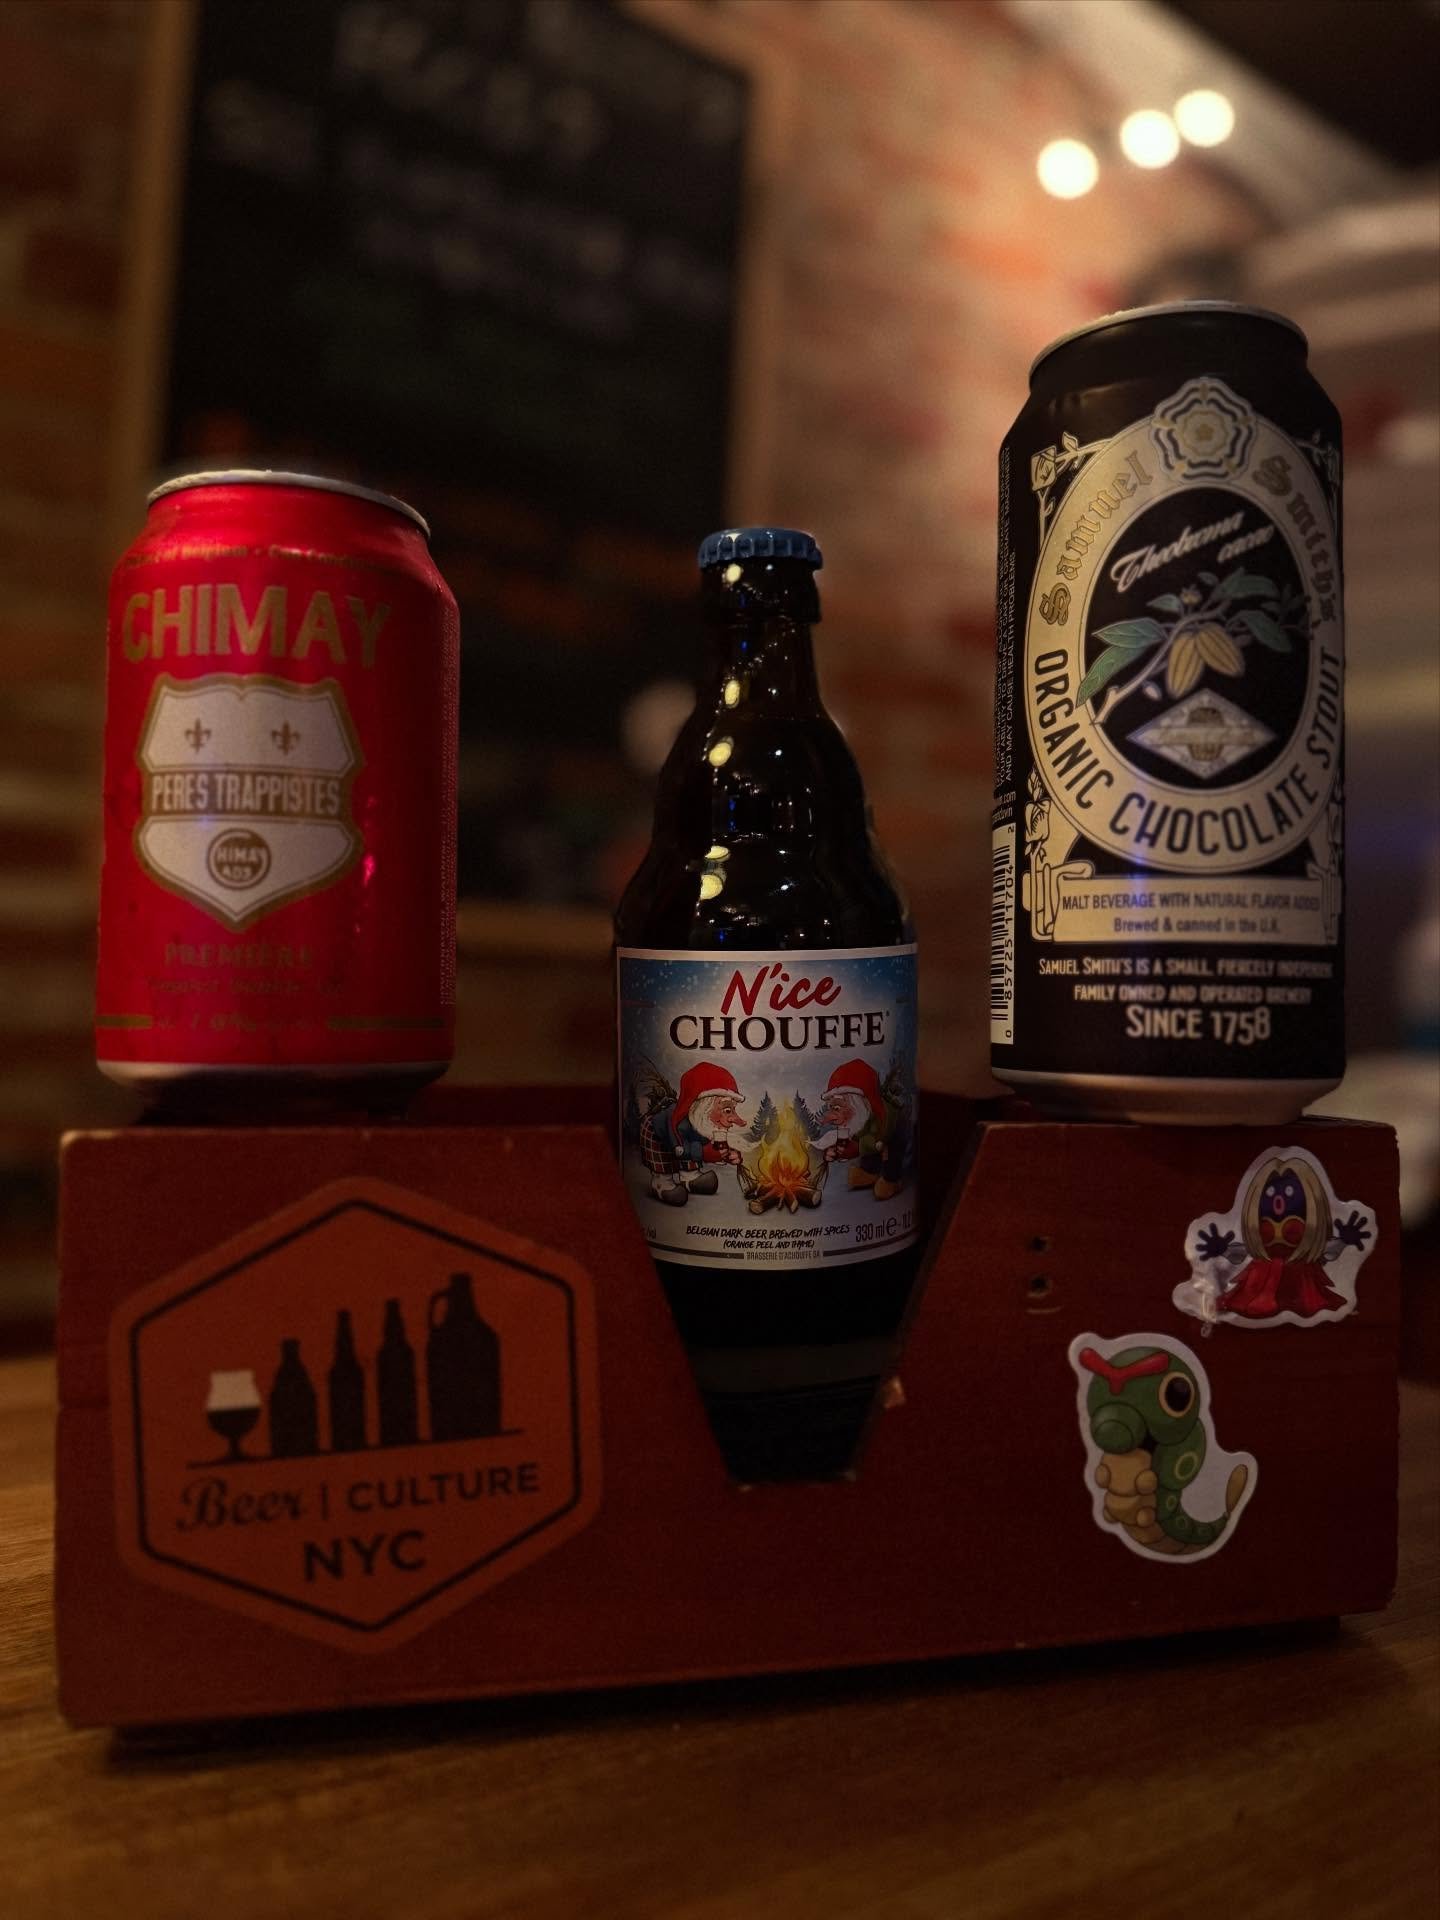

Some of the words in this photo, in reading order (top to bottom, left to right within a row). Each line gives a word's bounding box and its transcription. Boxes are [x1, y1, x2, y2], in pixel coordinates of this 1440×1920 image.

[1039, 449, 1154, 626] Samuel
[120, 583, 393, 673] CHIMAY
[1034, 648, 1115, 809] ORGANIC
[1109, 763, 1319, 857] CHOCOLATE
[1306, 645, 1342, 770] STOUT
[214, 773, 341, 816] TRAPPISTES
[1005, 864, 1014, 923] 11704
[1062, 894, 1089, 910] MALT
[1093, 893, 1156, 909] BEVERAGE
[1160, 892, 1191, 908] WITH
[1194, 892, 1248, 909] NATURAL
[1114, 917, 1158, 932] Brewed
[1163, 917, 1172, 932] &
[1176, 917, 1221, 932] canned
[1004, 938, 1013, 1000] 85725
[1038, 958, 1080, 975] SAMUEL
[1082, 956, 1133, 976] SMITH'S
[1135, 957, 1150, 976] IS
[1152, 957, 1164, 976] A
[721, 962, 842, 1016] N'ice
[1074, 984, 1117, 1001] FAMILY
[1118, 984, 1167, 1002] OWNED
[1168, 984, 1198, 1003] AND
[669, 1011, 886, 1051] CHOUFFE
[1125, 1003, 1204, 1039] SINCE
[1210, 1005, 1272, 1046] 1758
[686, 1225, 721, 1238] BELGIAN
[720, 1227, 744, 1239] DARK
[744, 1229, 768, 1239] BEER
[769, 1228, 801, 1240] BREWED
[803, 1226, 822, 1238] WITH
[823, 1224, 850, 1237] SPICES
[755, 1240, 774, 1249] PEEL
[775, 1239, 790, 1249] AND
[855, 1223, 874, 1242] 330
[875, 1219, 885, 1239] ml
[746, 1250, 777, 1261] BRASSERIE
[176, 1475, 304, 1533] Beer
[347, 1461, 541, 1513] CULTURE
[303, 1530, 426, 1583] NYC
